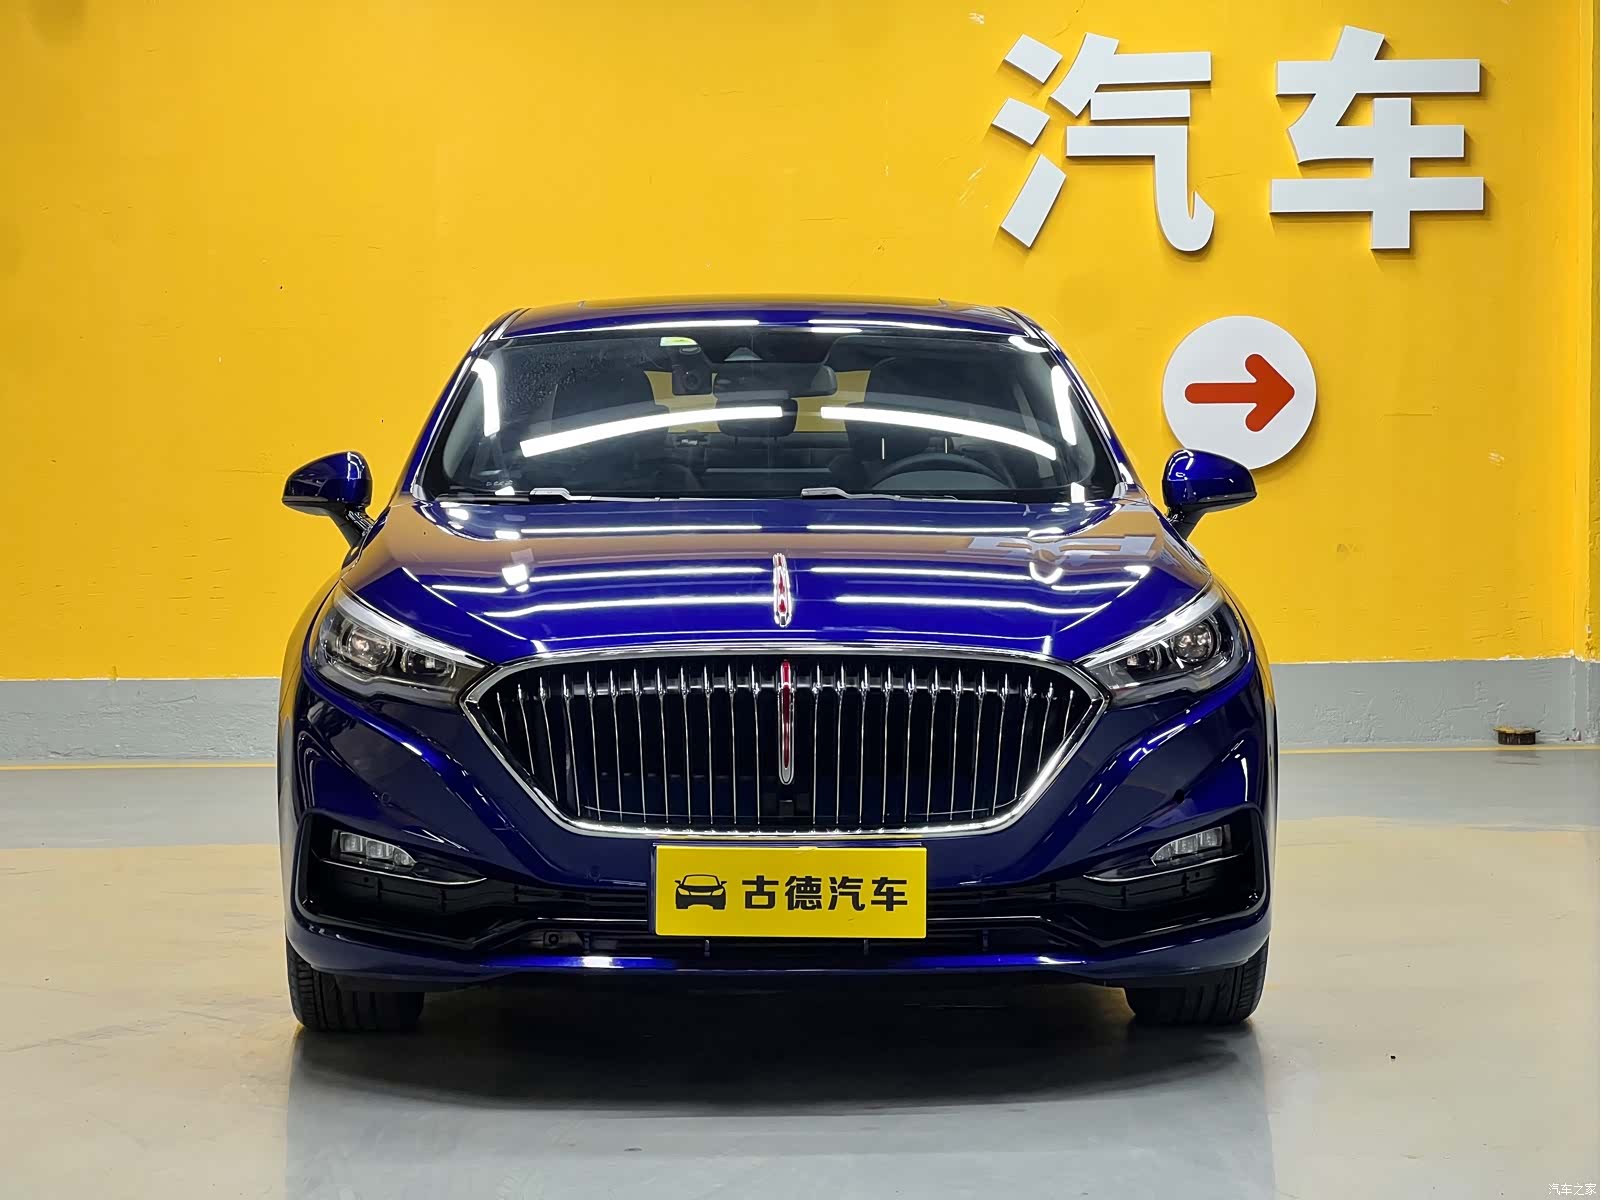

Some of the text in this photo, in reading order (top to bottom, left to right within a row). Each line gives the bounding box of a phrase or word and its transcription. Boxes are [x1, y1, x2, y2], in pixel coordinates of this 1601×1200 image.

[991, 25, 1484, 252] 汽车
[742, 875, 908, 911] 古德汽车
